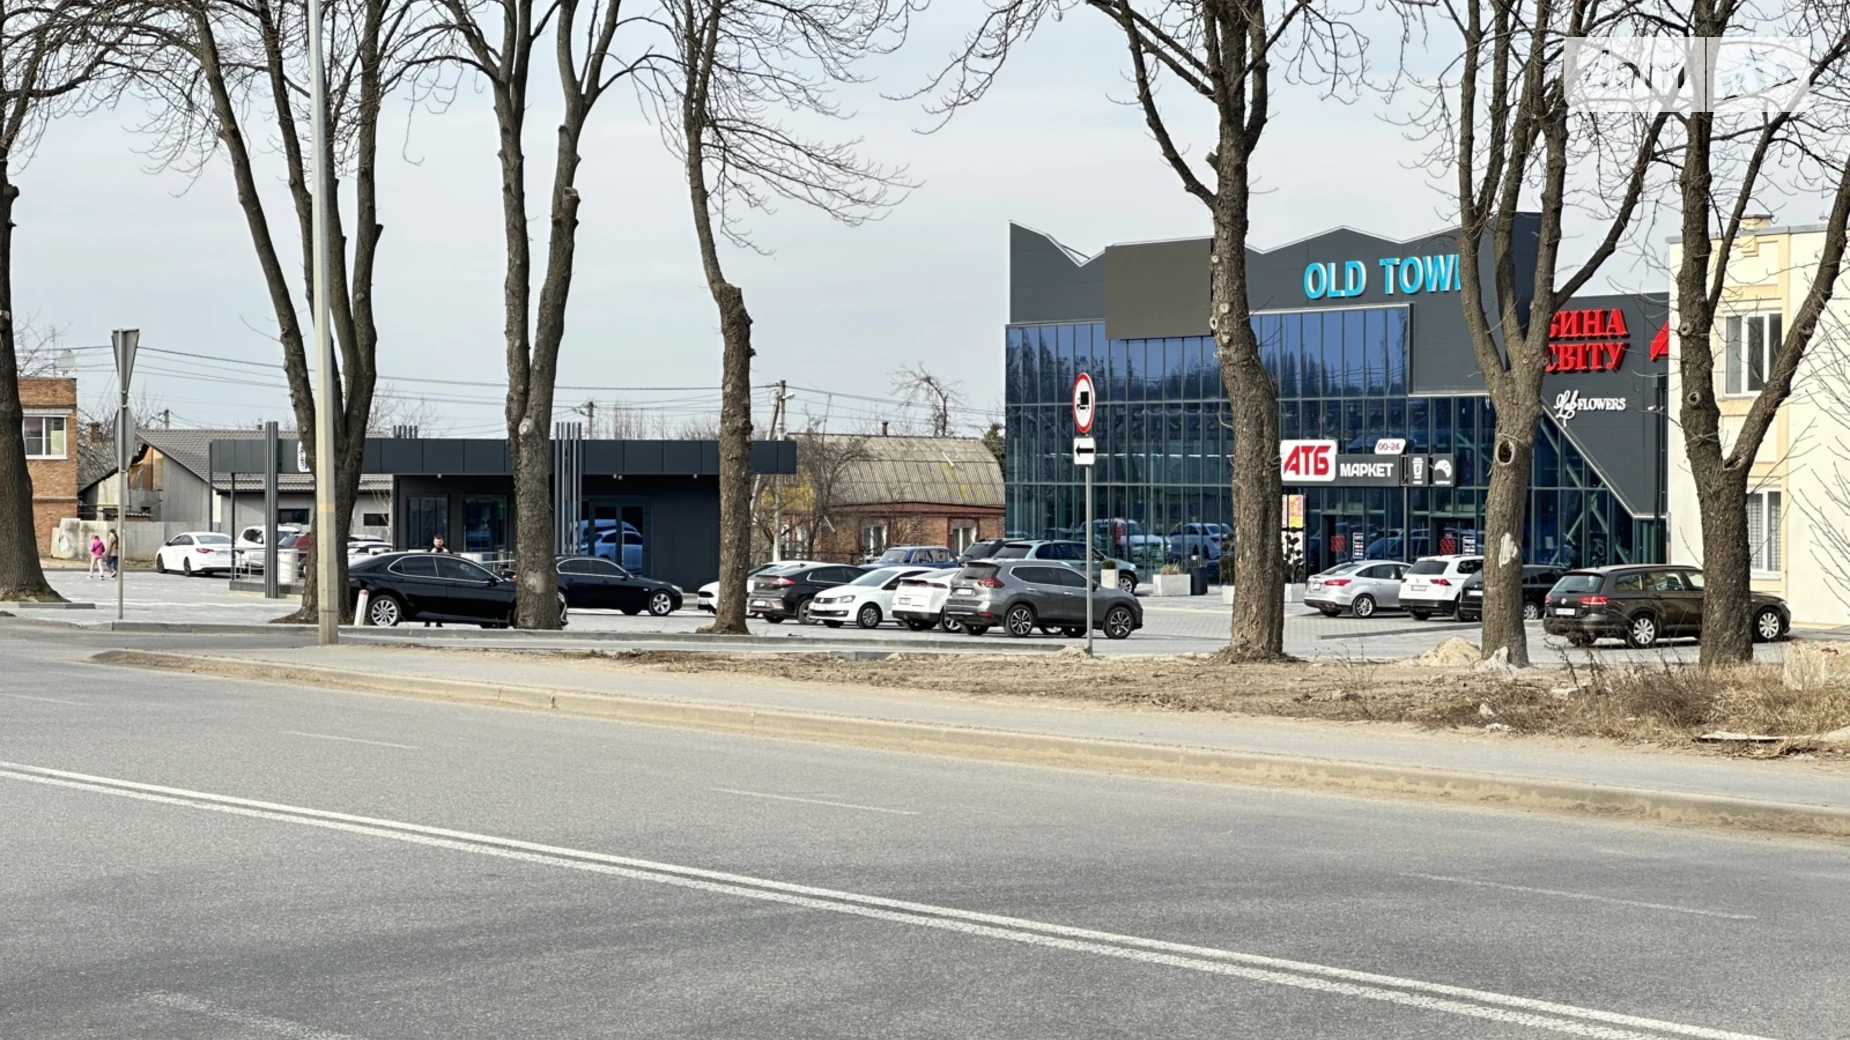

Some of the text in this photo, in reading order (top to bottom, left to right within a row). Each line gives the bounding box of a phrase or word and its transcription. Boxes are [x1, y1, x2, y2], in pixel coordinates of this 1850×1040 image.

[1303, 260, 1368, 300] OLD
[1577, 397, 1627, 411] FLOWERS
[1377, 442, 1401, 452] 00-24
[1283, 445, 1332, 476] АТБ
[1340, 463, 1394, 477] МАРКЕТ
